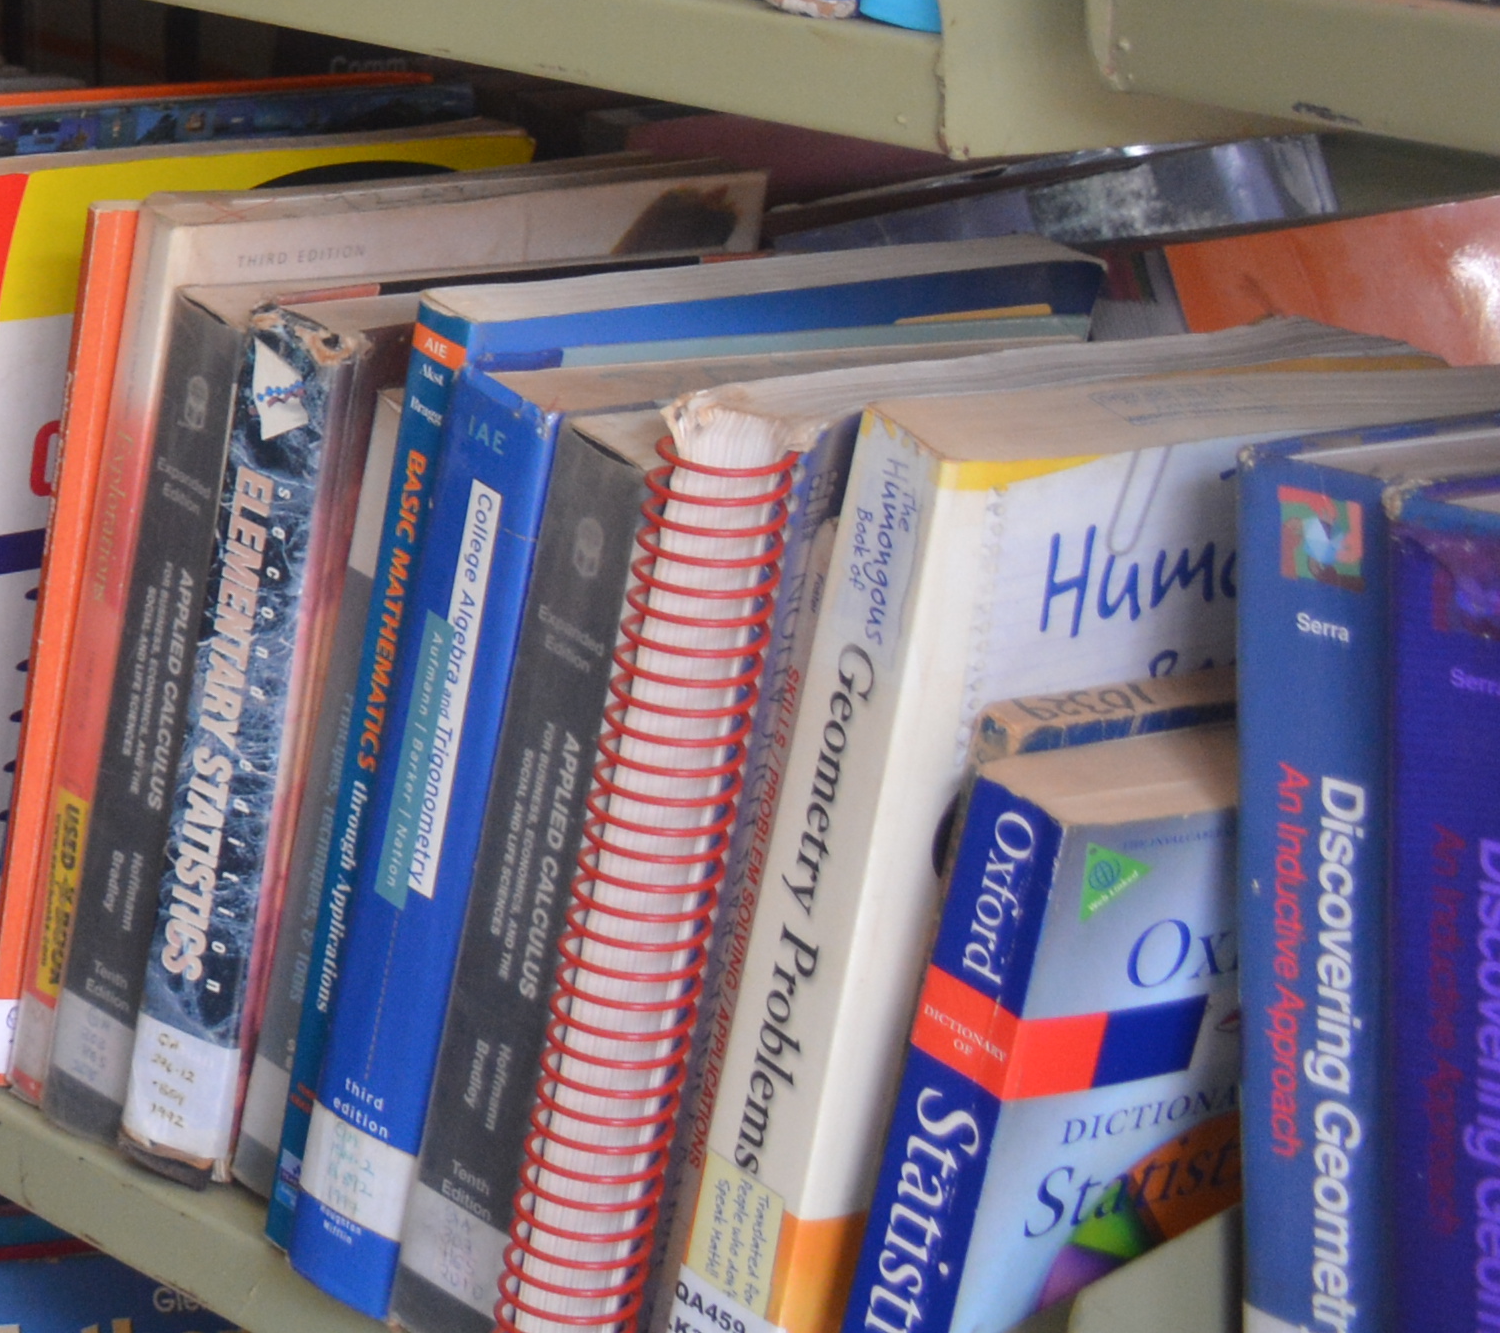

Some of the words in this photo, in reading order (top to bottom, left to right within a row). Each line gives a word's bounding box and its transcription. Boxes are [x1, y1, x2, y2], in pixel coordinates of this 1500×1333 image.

[236, 249, 288, 271] THIRD
[296, 243, 366, 264] EDITION
[398, 448, 428, 543] BASIC
[464, 493, 493, 584] College
[853, 506, 873, 561] Book
[898, 490, 917, 533] The
[848, 563, 865, 592] of
[863, 457, 909, 647] Humongous
[200, 464, 276, 755] ELEMENTARY
[356, 547, 412, 773] MATHEMATICS
[449, 589, 477, 686] Algebra
[1296, 611, 1350, 644] Serra
[440, 689, 452, 721] and
[347, 778, 371, 872] through
[407, 722, 453, 886] Trigonometry
[551, 731, 580, 838] APPLIED
[780, 642, 876, 927] Geometry
[1278, 762, 1310, 814] An
[162, 747, 234, 982] STATISTICS
[961, 806, 1037, 986] Oxford
[1274, 822, 1310, 980] Inductive
[316, 882, 355, 1014] Applications
[519, 842, 566, 1002] CALCULUS
[1304, 776, 1365, 1093] Discovering
[732, 922, 820, 1178] Problems
[924, 1004, 1008, 1064] DICTIONARY
[953, 1037, 974, 1057] OF
[1266, 984, 1308, 1158] Approach
